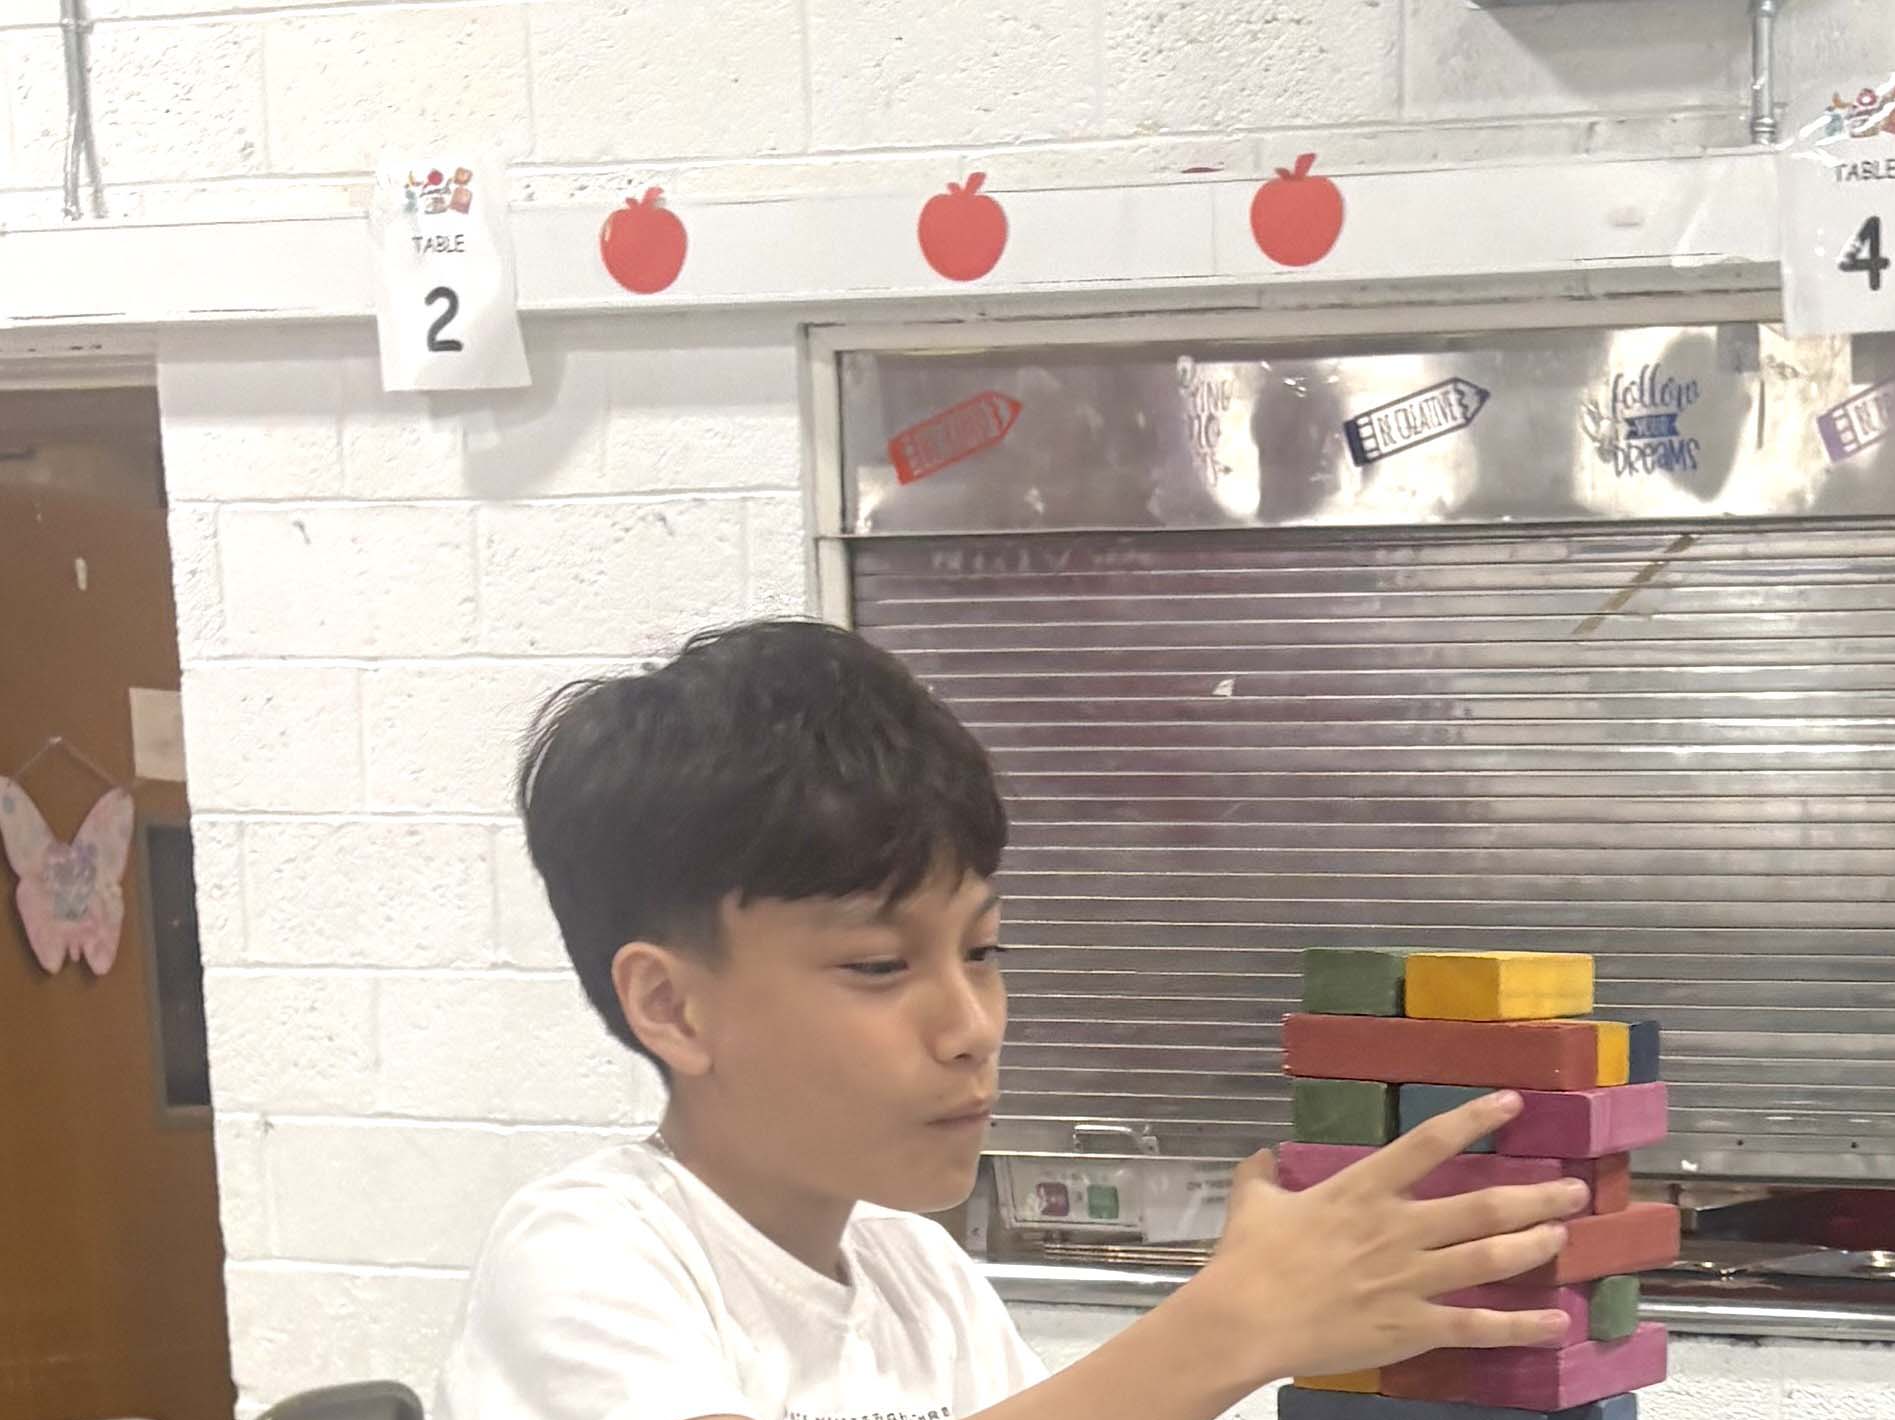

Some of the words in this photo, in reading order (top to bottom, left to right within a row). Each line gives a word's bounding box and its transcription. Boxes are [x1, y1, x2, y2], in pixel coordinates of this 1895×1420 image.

[412, 234, 465, 254] TABLE
[1838, 215, 1890, 291] 4
[425, 286, 463, 352] 2
